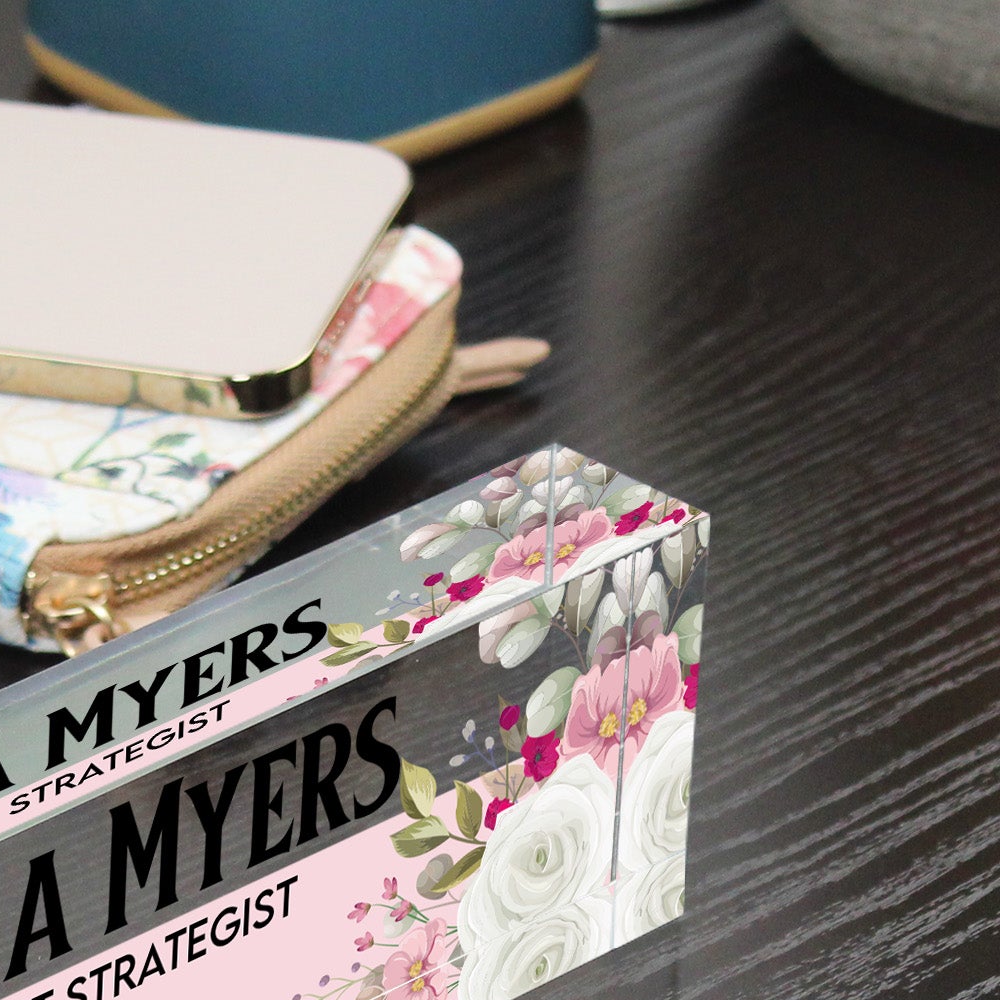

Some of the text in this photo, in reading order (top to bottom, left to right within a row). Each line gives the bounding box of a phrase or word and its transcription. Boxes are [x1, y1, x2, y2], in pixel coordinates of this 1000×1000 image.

[8, 700, 231, 815] STRATEGIST
[44, 598, 328, 771] MYERS
[104, 696, 401, 934] MYERS
